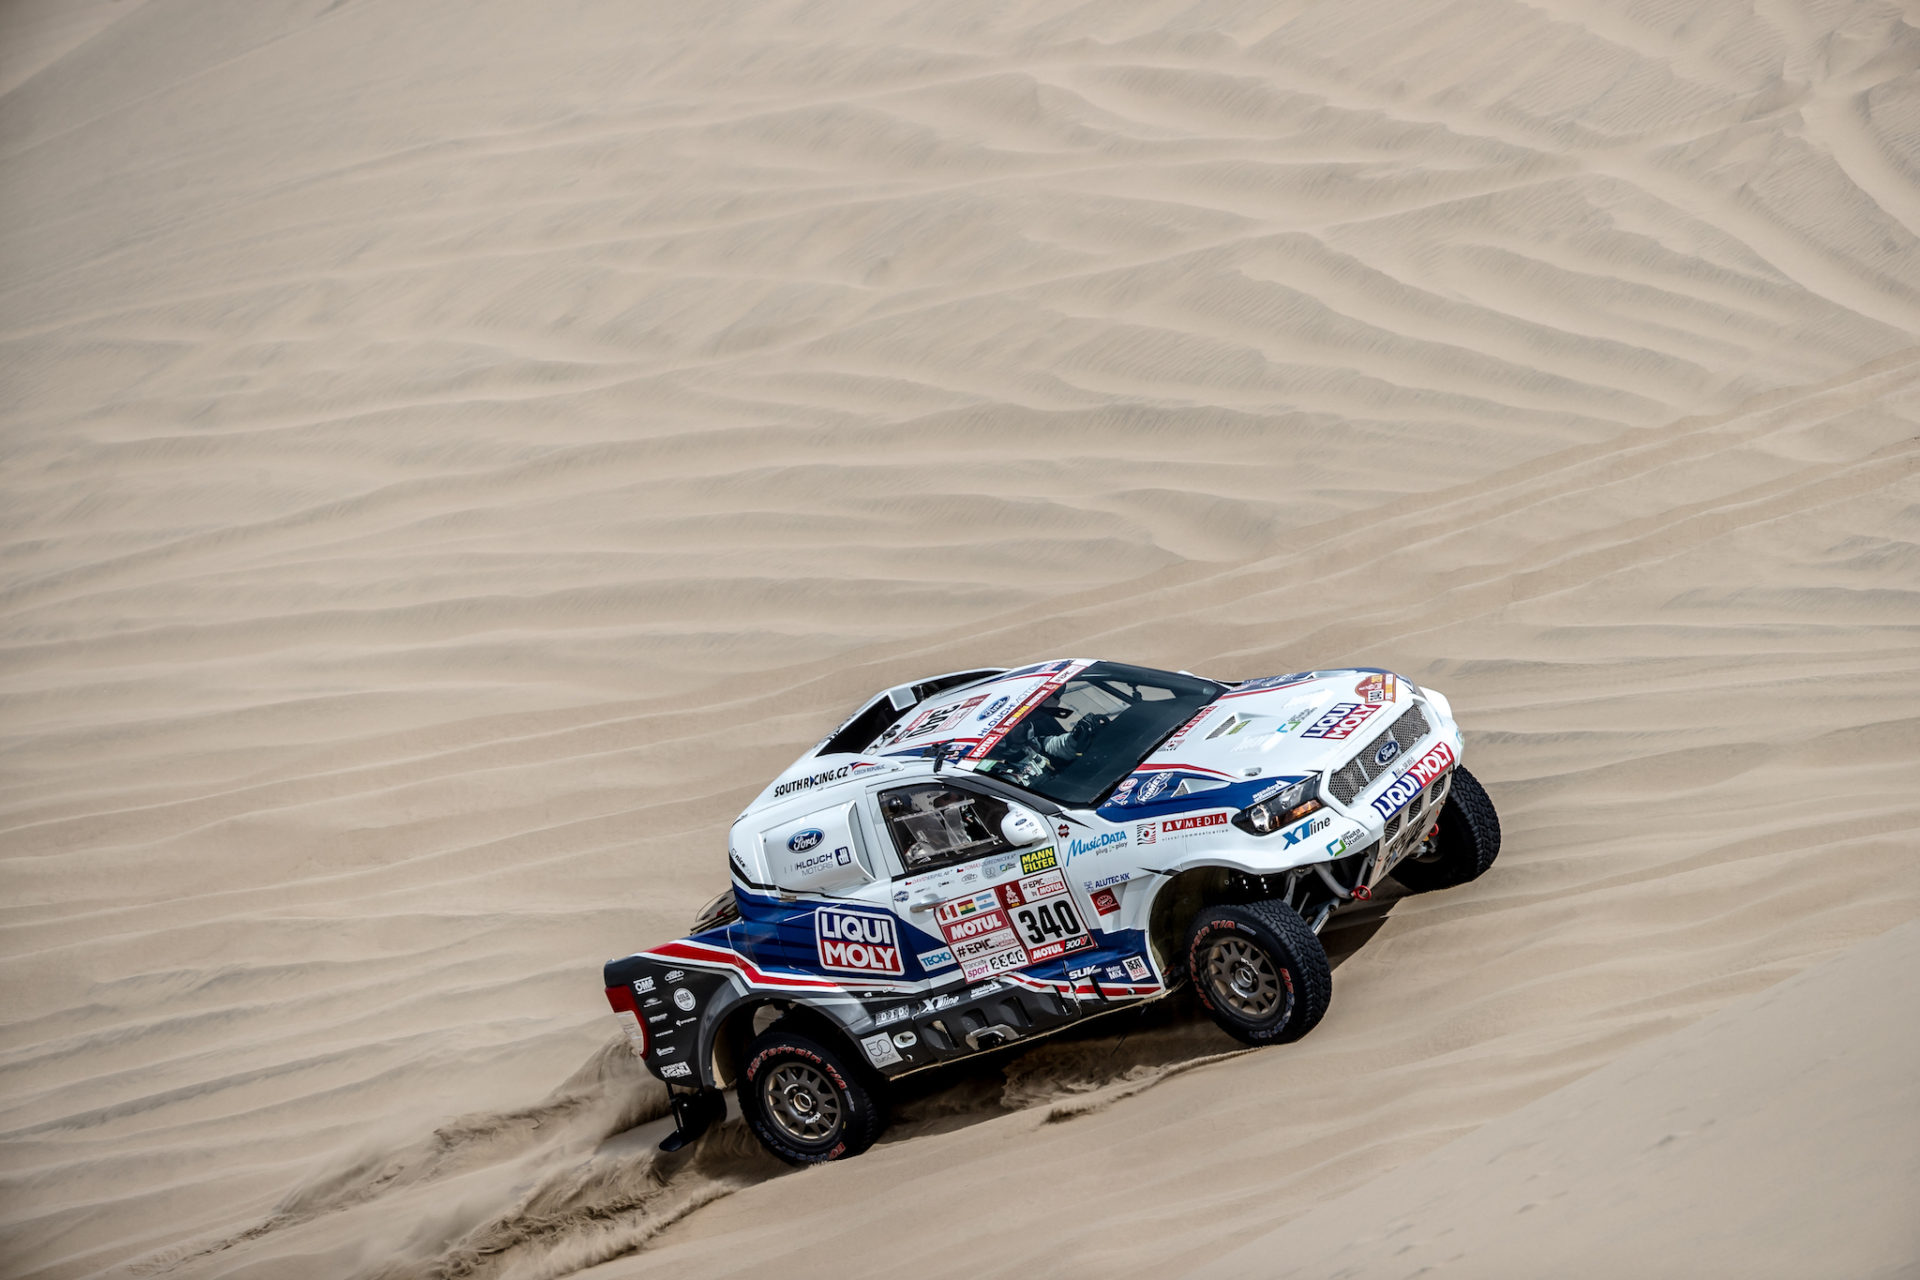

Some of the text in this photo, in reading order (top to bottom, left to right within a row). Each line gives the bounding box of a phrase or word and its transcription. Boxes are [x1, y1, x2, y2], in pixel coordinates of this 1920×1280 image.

[978, 704, 1015, 736] HLOUCH
[1303, 703, 1357, 738] LIQUI
[1326, 704, 1377, 739] MOLY
[971, 735, 999, 757] MOTUL
[1373, 774, 1421, 818] LIQUI
[1410, 743, 1453, 784] MOLY
[792, 831, 818, 851] Ford
[1282, 817, 1331, 851] XTline
[796, 852, 833, 870] HLOUCH
[1022, 848, 1054, 864] MANN
[1024, 857, 1056, 873] FILTER
[1040, 882, 1064, 896] MOTUL
[1095, 875, 1119, 888] ALUTEC
[821, 913, 891, 944] LIQUI
[950, 913, 1002, 941] MOTUL
[1018, 900, 1081, 944] 340
[1211, 919, 1235, 930] T/A
[823, 941, 895, 970] MOLY
[1033, 935, 1088, 960] MOTUL 300V
[922, 951, 952, 966] TECHO
[967, 964, 989, 979] sport
[1068, 965, 1097, 980] SUV
[635, 978, 654, 991] OMP
